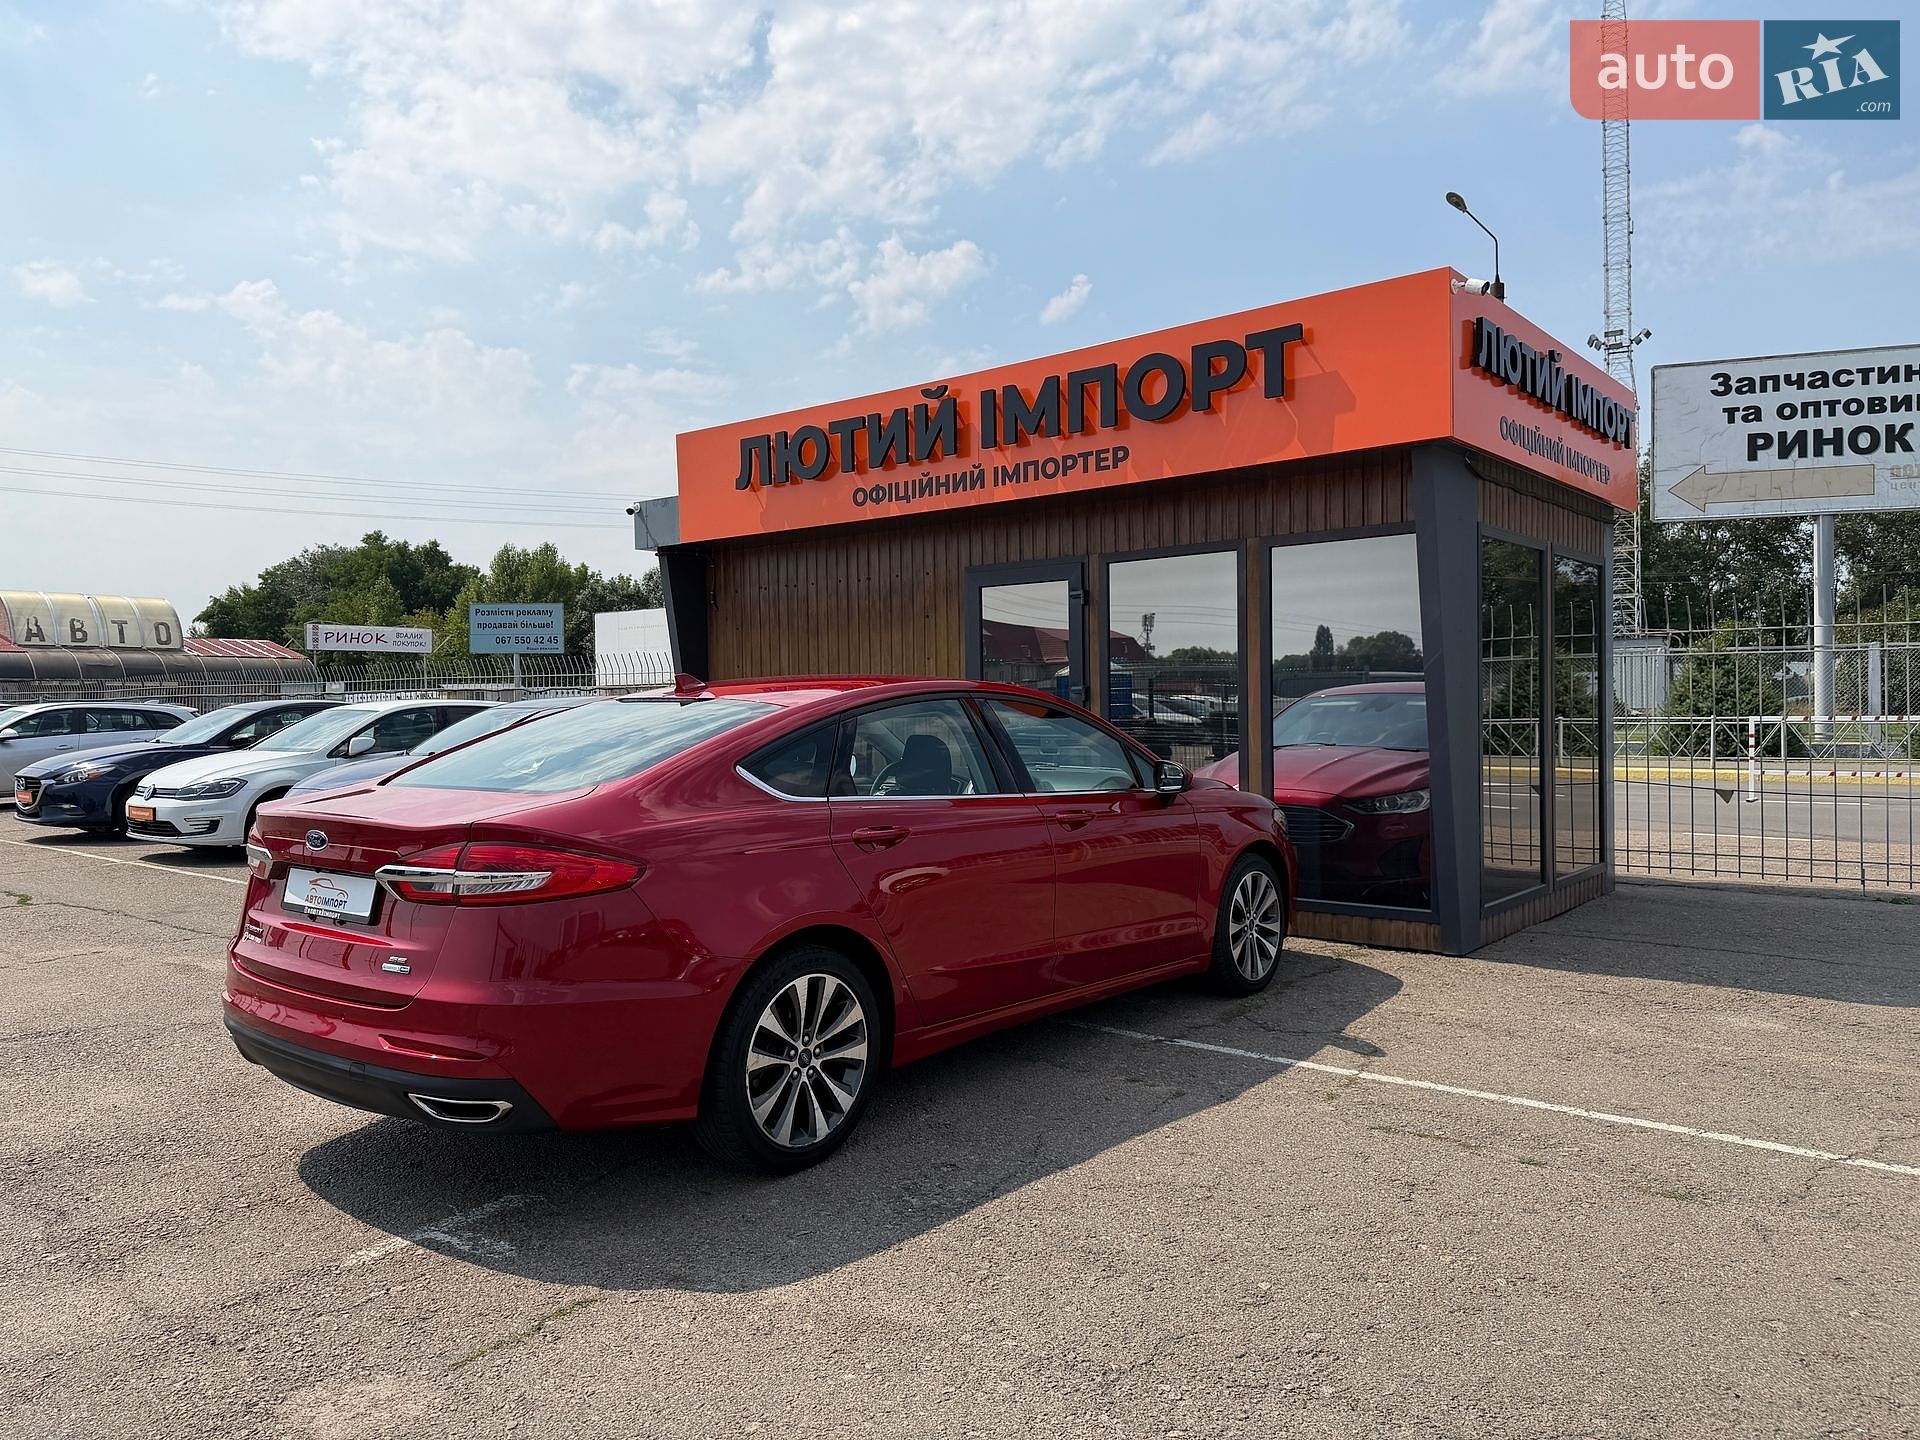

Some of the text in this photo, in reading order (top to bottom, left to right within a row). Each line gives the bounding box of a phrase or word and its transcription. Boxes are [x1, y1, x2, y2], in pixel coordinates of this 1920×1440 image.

[1473, 316, 1637, 449] ЛЮТИЙ ІМПОРТ
[735, 323, 1304, 491] ЛЮТИЙ ІМПОРТ
[1722, 393, 1920, 425] та оптови
[1499, 415, 1611, 485] ОФІЦІЙНИЙ ІМПОРТЕР
[1747, 422, 1915, 462] РИНОК
[852, 445, 1130, 507] ОФІЦІЙНИЙ ІМПОРТЕР
[475, 608, 554, 617] Розмісти рекламу
[477, 620, 554, 630] продавай більше!
[25, 616, 172, 646] АВТО
[323, 631, 388, 644] РИНОК
[495, 635, 559, 645] 067 550 42 45
